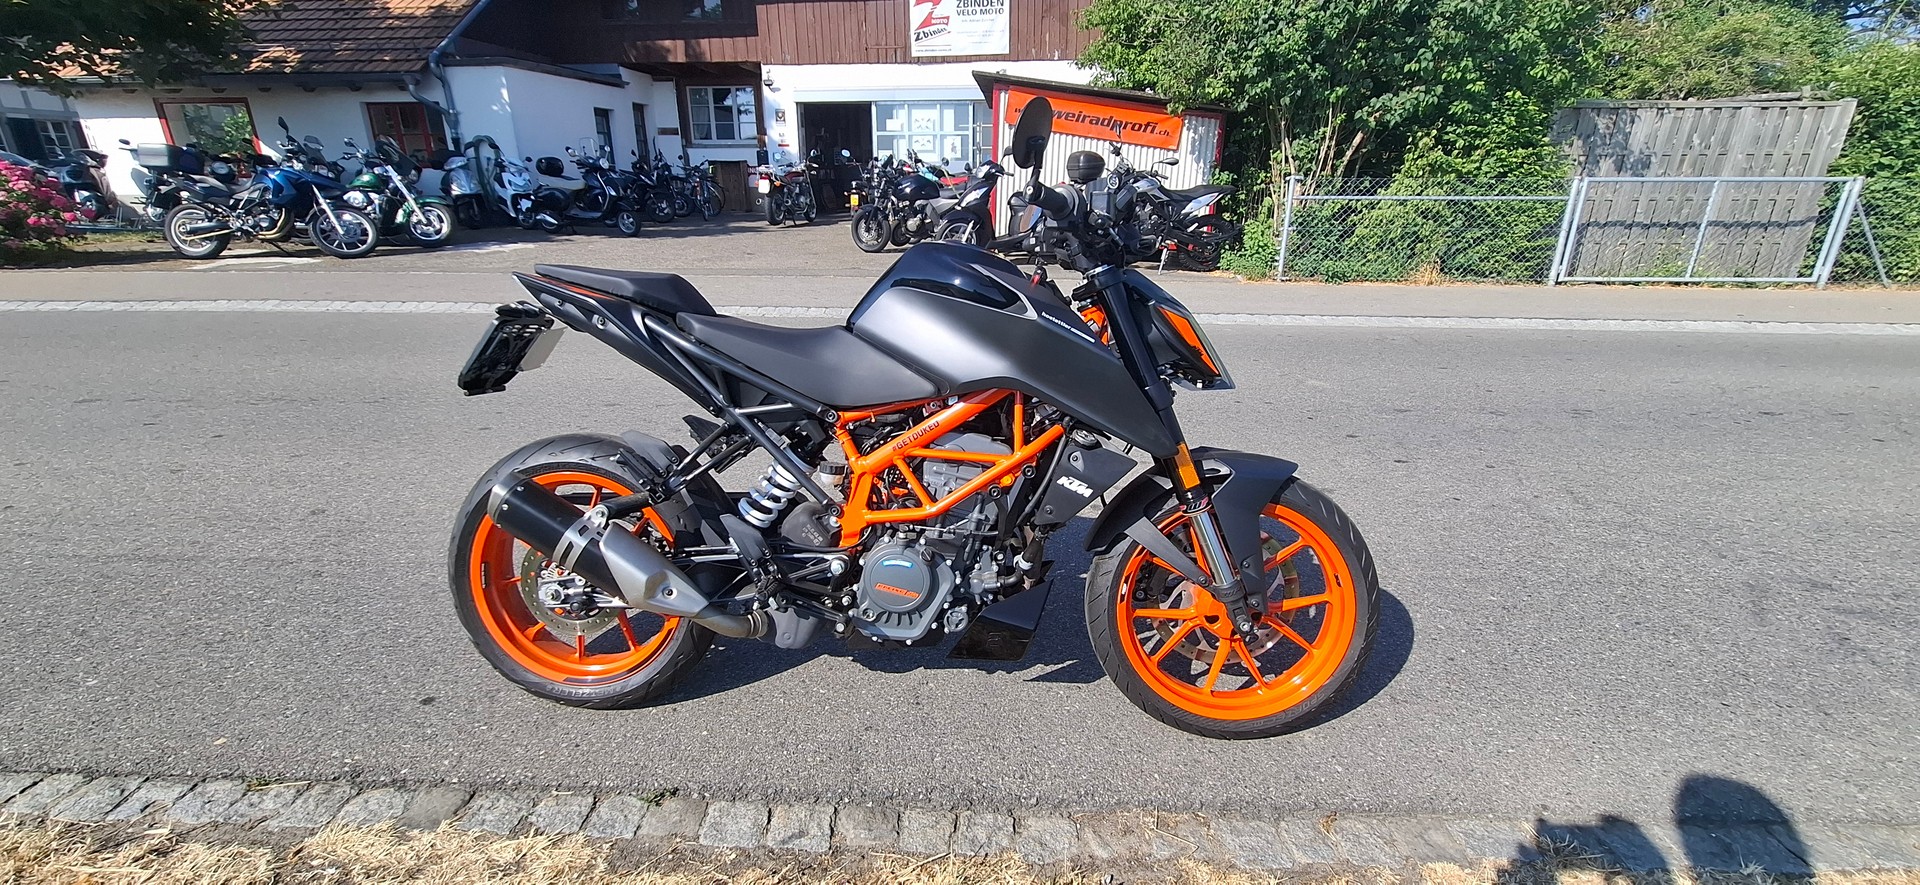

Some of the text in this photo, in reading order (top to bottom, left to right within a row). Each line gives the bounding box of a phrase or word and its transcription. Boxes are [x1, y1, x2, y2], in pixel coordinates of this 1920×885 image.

[956, 0, 1004, 8] ZBINDEN
[892, 420, 940, 451] #GETDUKED
[1056, 475, 1094, 498] KTM
